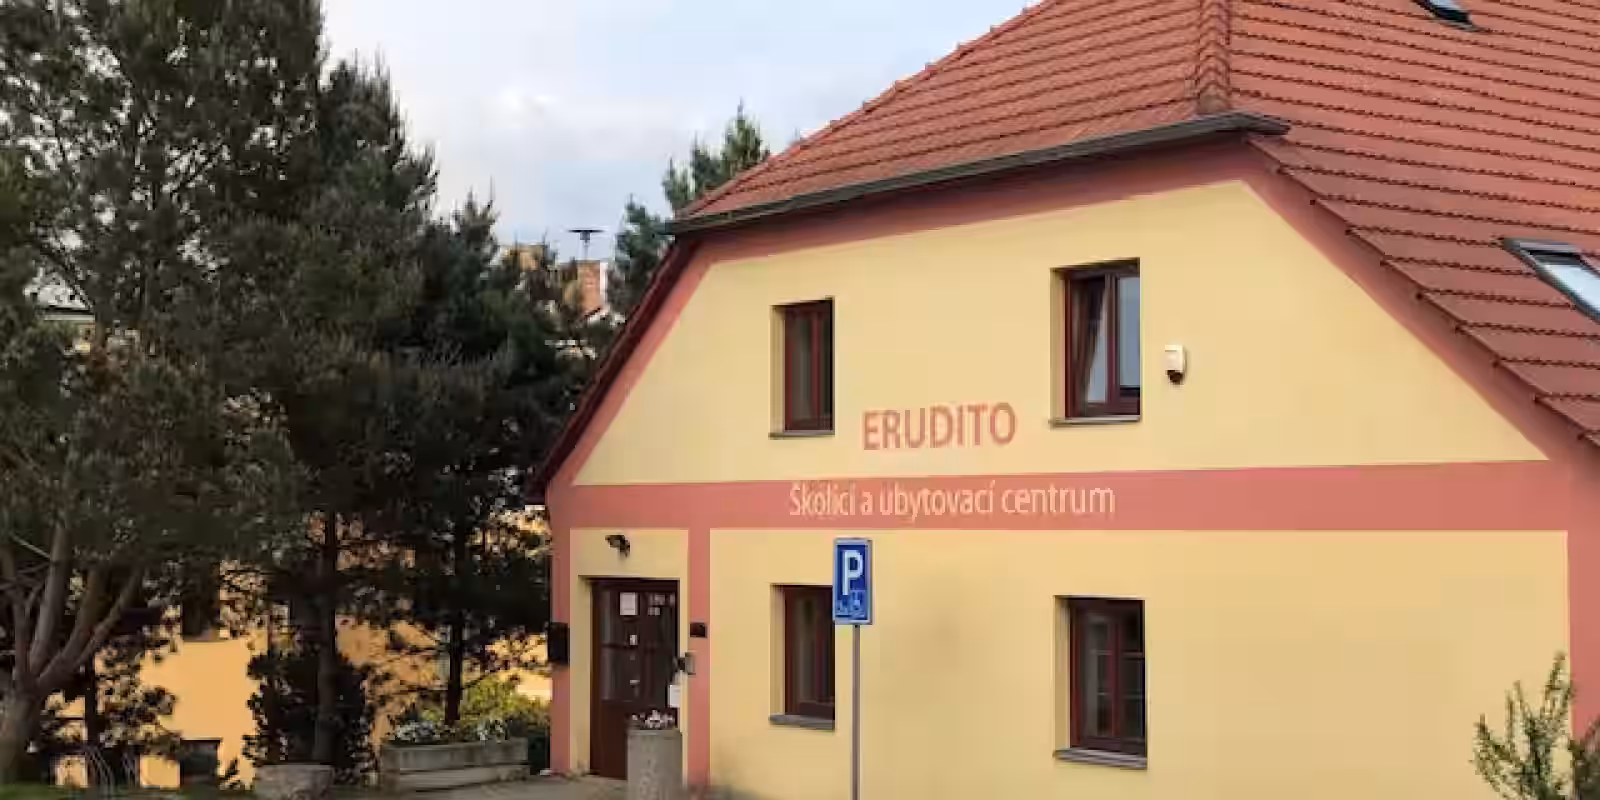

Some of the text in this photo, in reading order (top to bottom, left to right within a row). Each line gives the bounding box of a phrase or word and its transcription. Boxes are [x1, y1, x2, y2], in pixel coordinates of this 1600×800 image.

[863, 402, 1016, 450] ERUDITO
[861, 491, 873, 516] a
[880, 480, 995, 522] ubytovací
[1002, 484, 1116, 514] centrum
[842, 550, 863, 595] P
